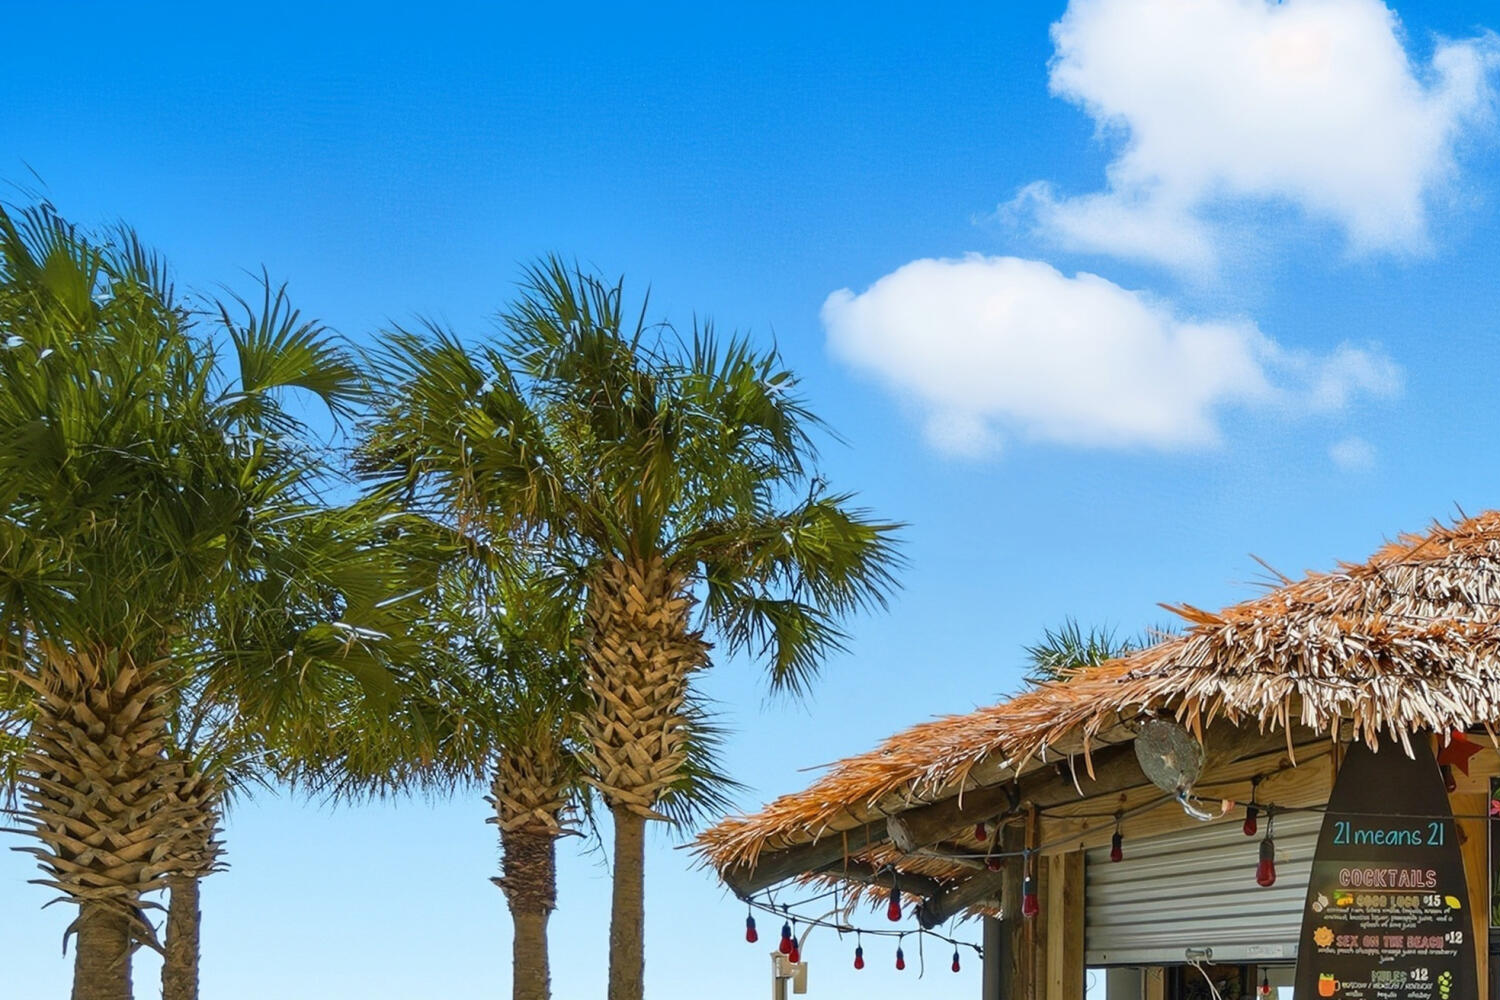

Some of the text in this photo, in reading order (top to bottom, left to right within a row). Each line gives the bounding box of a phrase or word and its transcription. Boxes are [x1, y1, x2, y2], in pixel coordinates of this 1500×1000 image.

[1333, 821, 1444, 846] 21 means 21
[1338, 867, 1438, 888] COCKTAILS
[1423, 894, 1442, 907] $15
[1336, 931, 1464, 949] SEX ON THE BEACH $12
[1410, 967, 1429, 981] $12
